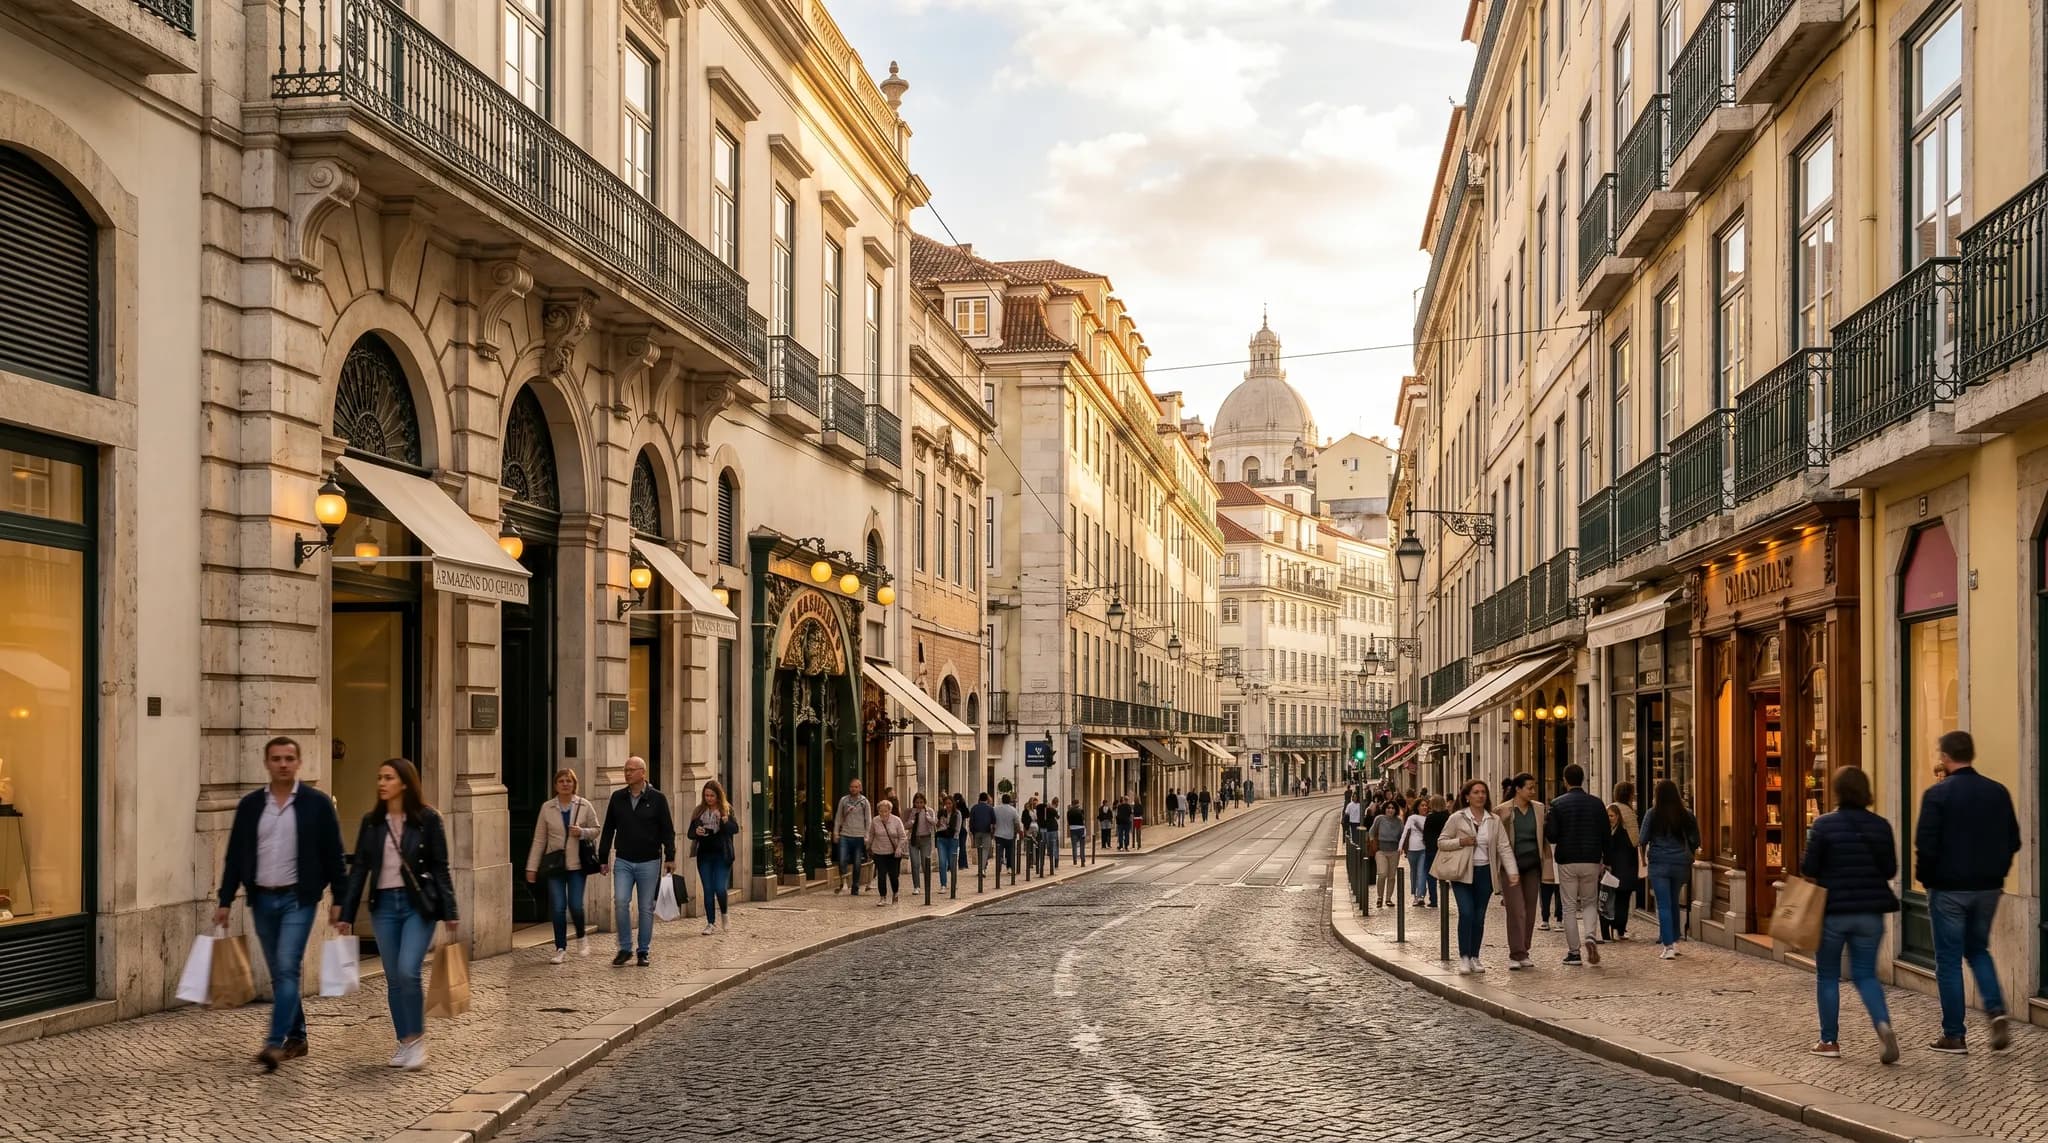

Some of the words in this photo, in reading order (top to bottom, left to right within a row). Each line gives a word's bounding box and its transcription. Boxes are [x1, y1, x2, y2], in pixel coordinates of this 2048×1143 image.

[436, 569, 481, 591] ARMAZÉNS
[482, 576, 495, 592] DO
[495, 579, 525, 598] CHIADO
